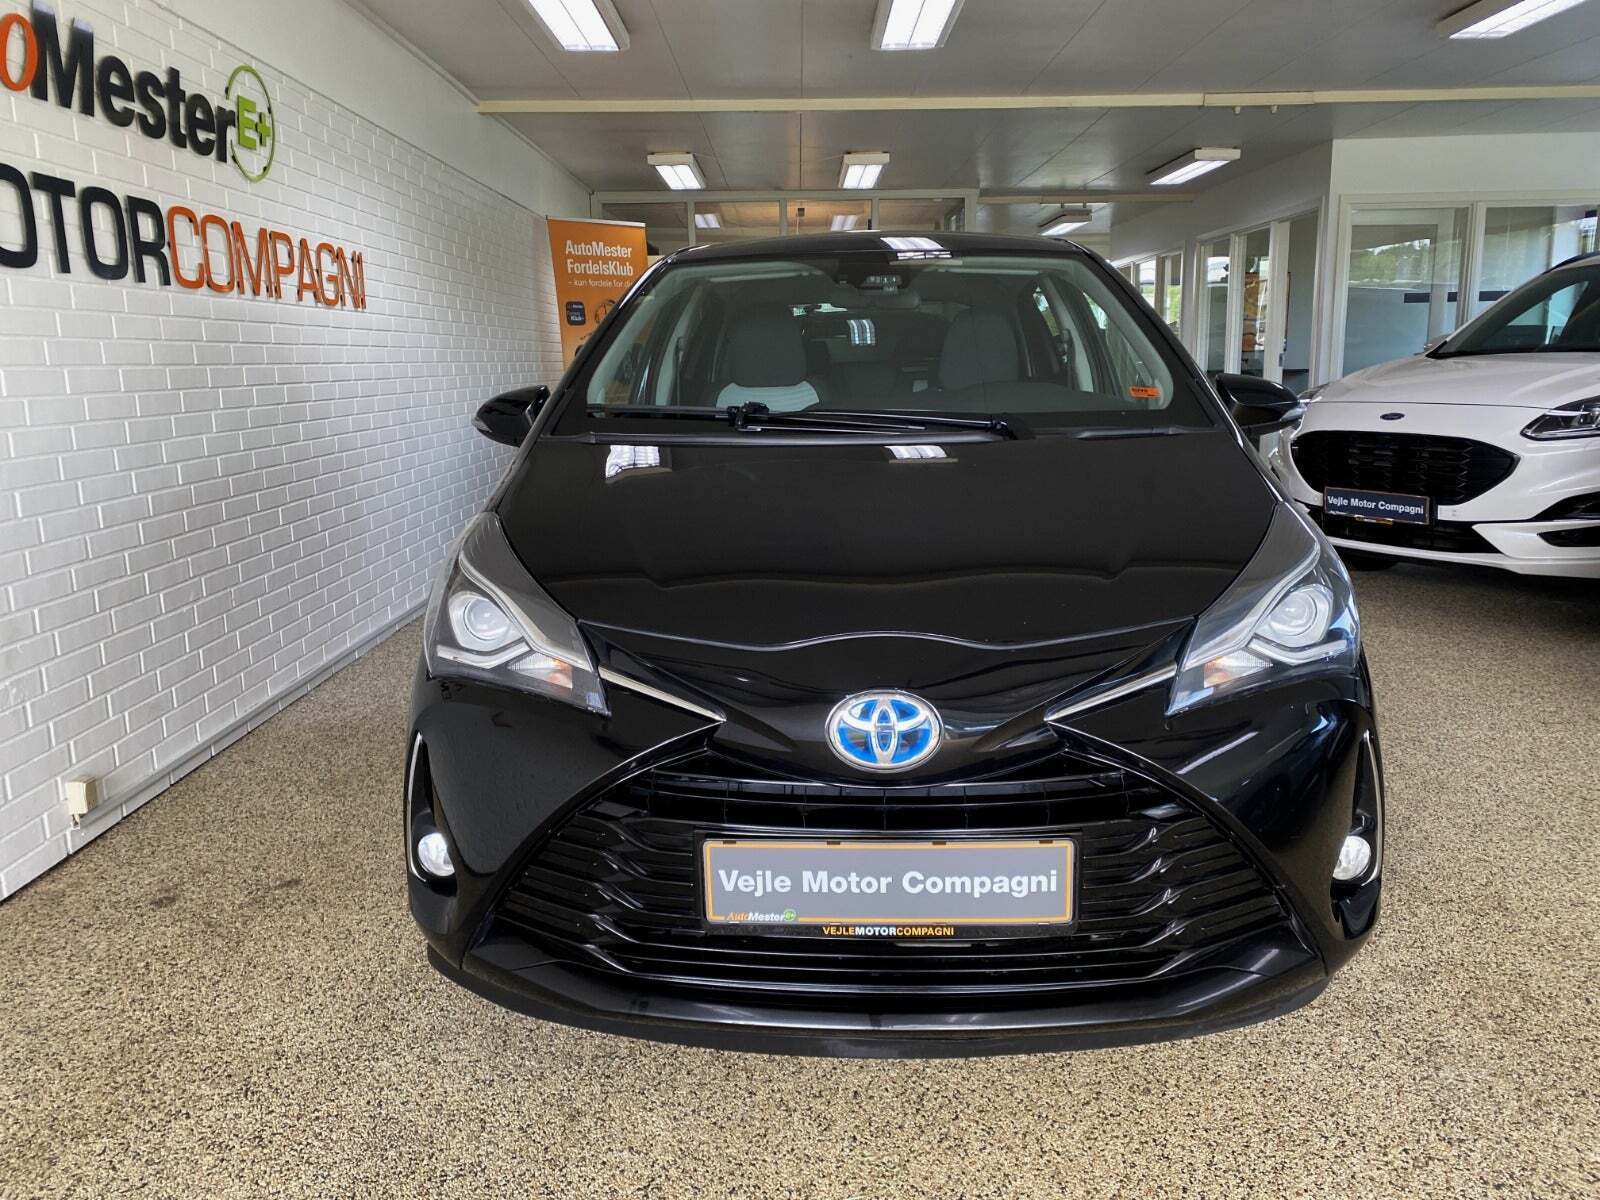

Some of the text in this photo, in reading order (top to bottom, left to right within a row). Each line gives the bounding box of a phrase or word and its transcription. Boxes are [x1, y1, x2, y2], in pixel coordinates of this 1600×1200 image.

[565, 240, 632, 258] AutoMester
[567, 258, 634, 276] FordelsKlub
[1327, 496, 1424, 515] Vejle Motor Compagni
[718, 869, 1057, 898] Vejle Motor Compagni
[823, 926, 954, 937] VEJLEMOTORCOMPAGNI
